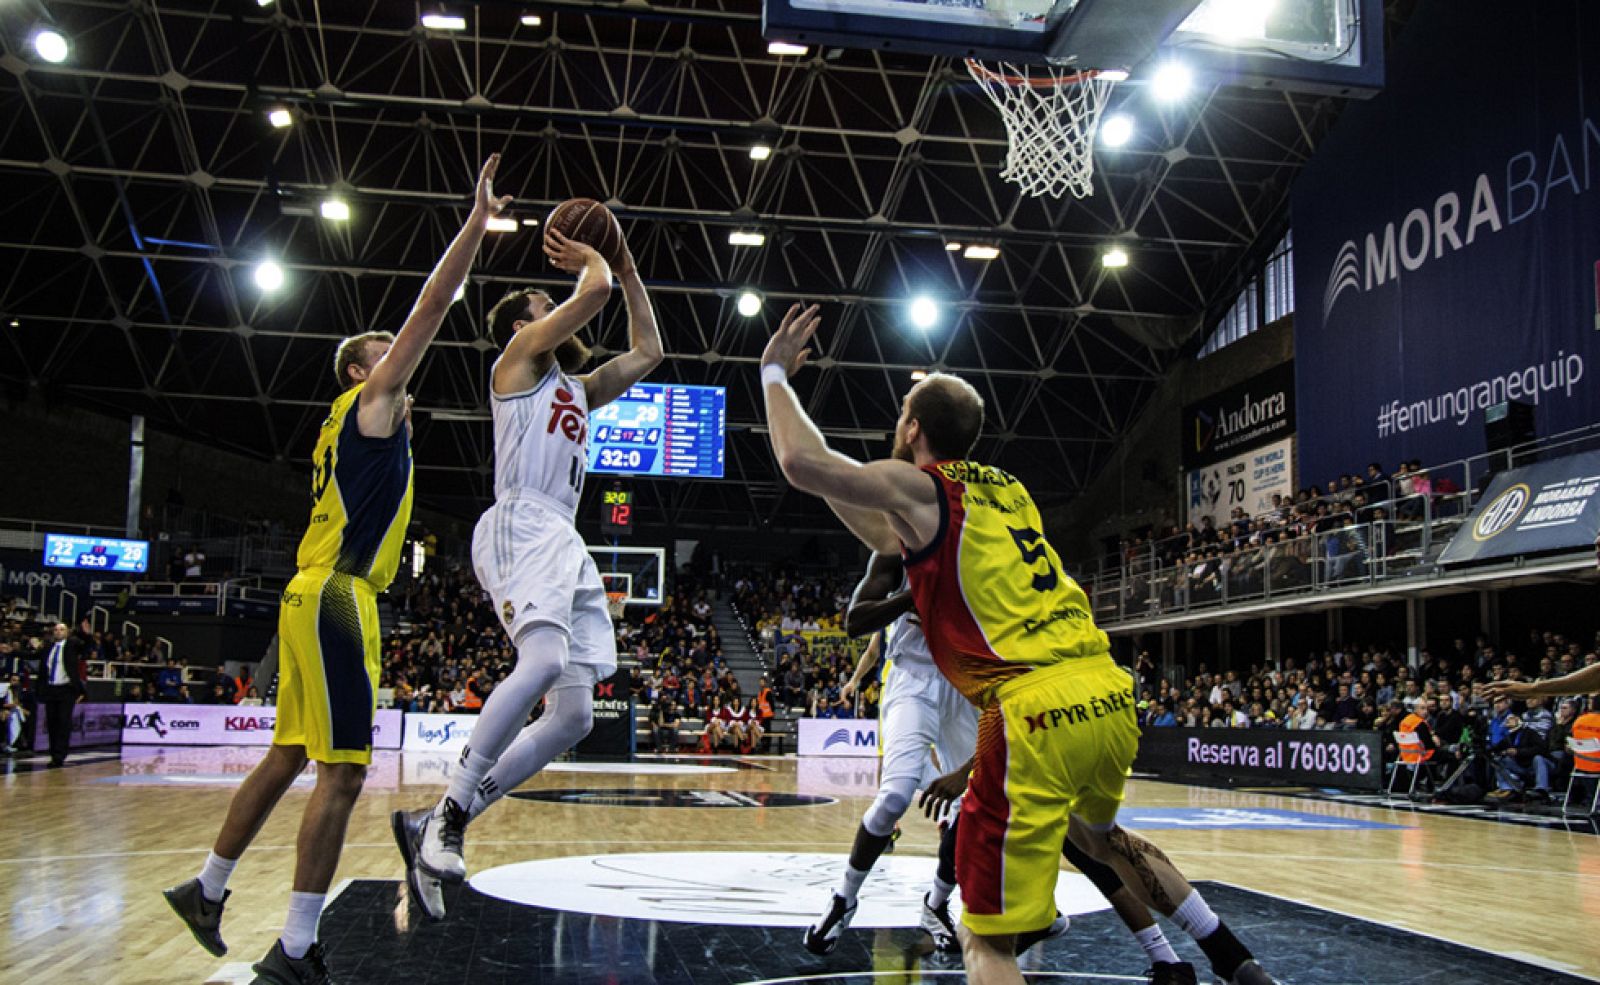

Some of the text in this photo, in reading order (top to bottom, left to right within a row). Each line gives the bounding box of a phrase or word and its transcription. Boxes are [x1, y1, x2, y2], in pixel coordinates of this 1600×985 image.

[1377, 350, 1584, 439] #femungranequip
[595, 403, 620, 421] 22
[635, 405, 659, 423] 29
[1214, 391, 1286, 440] Andorra
[597, 427, 609, 441] 4
[647, 429, 659, 444] 4
[600, 448, 642, 468] 32:0
[1227, 478, 1246, 506] 70
[611, 504, 631, 526] 12
[52, 540, 74, 556] 22
[1005, 525, 1059, 593] 5
[1187, 737, 1371, 775] Reserva al 760303
